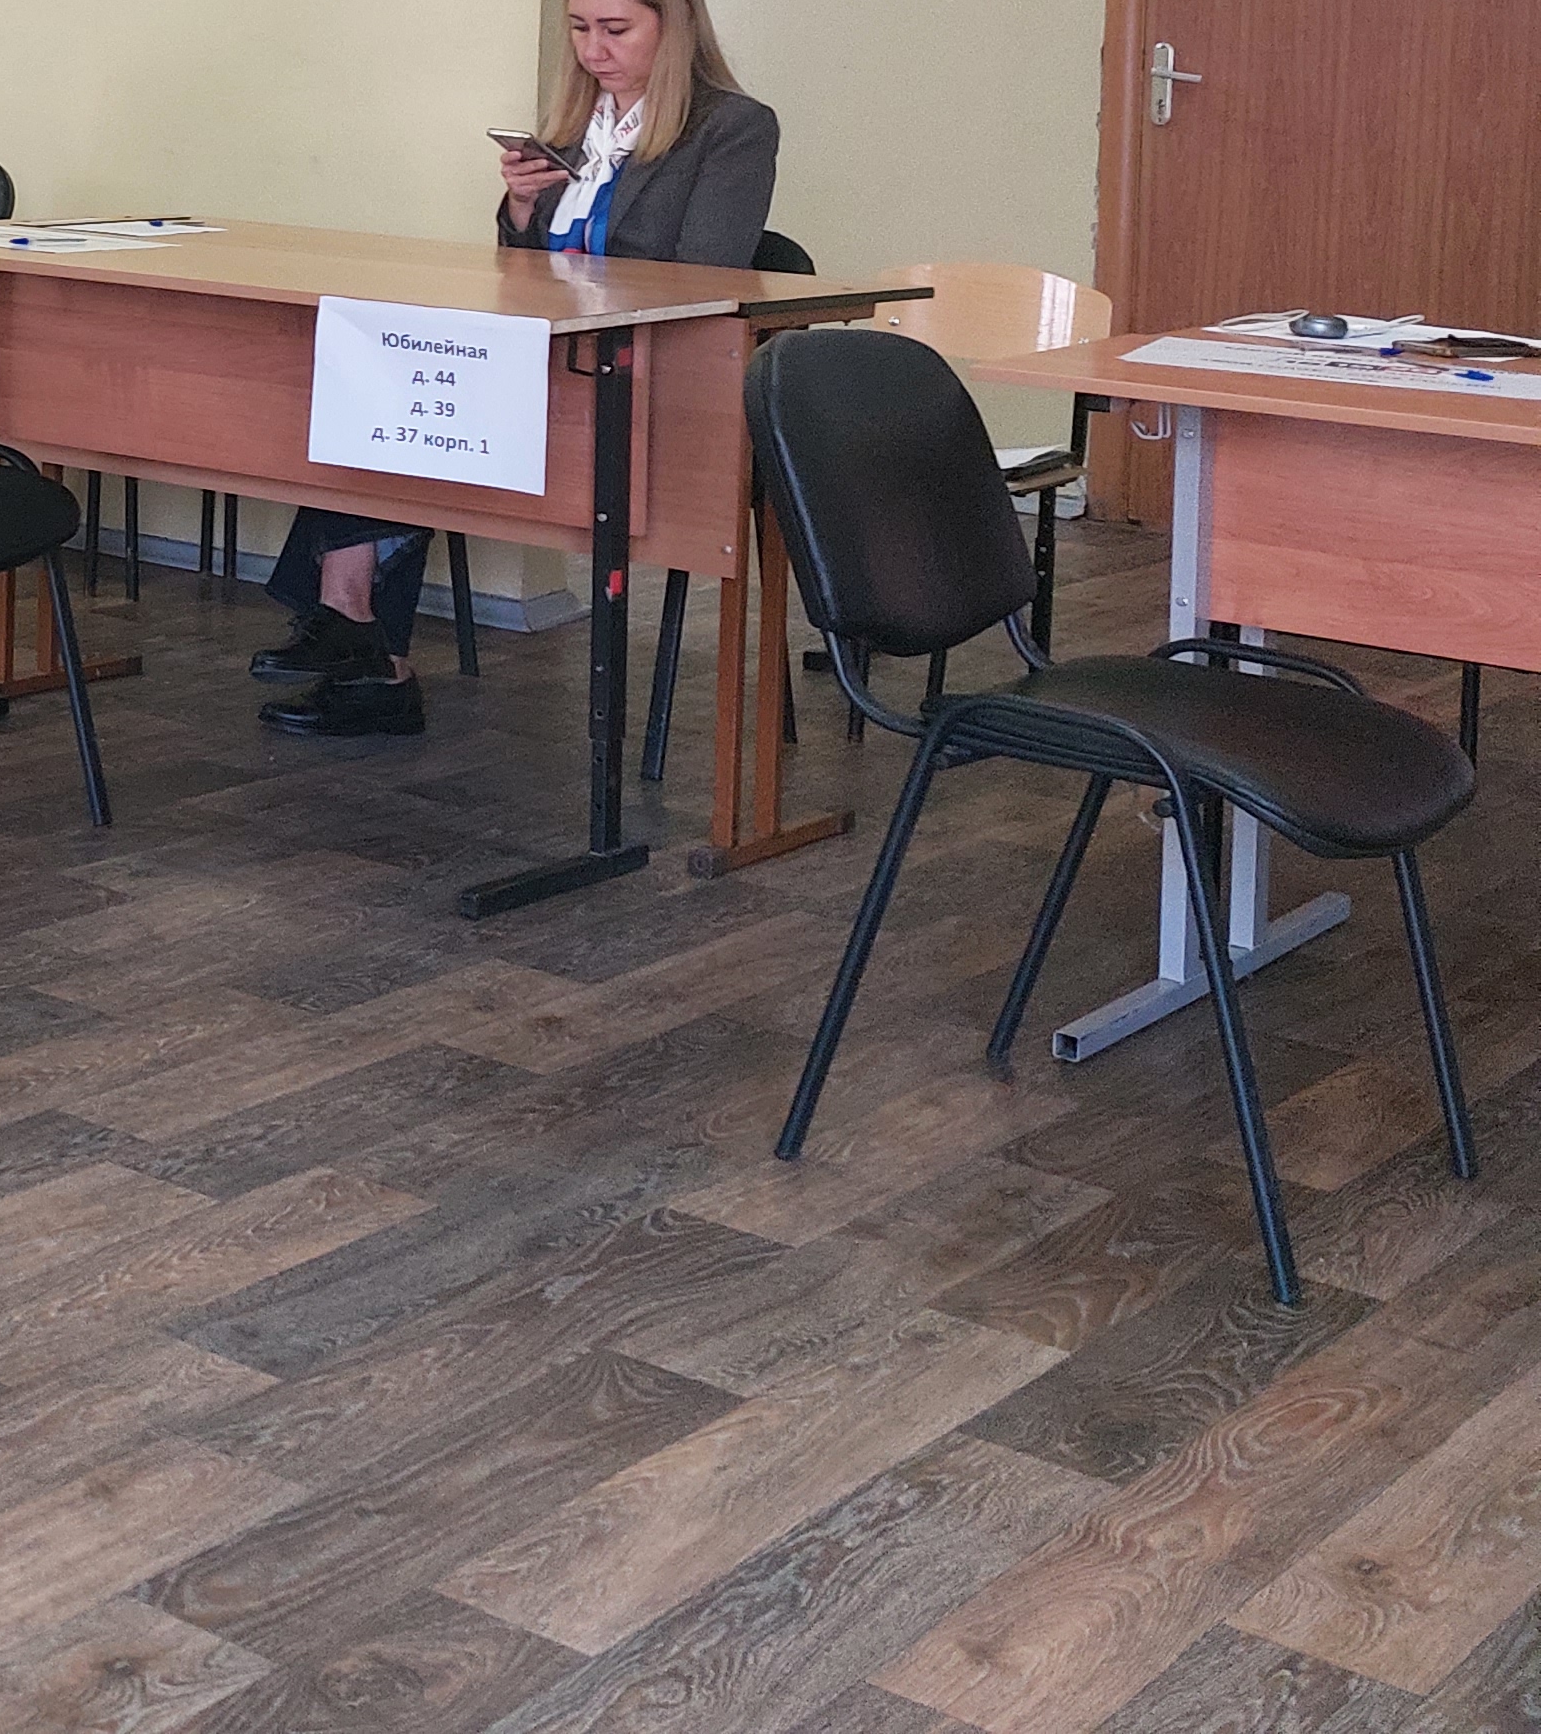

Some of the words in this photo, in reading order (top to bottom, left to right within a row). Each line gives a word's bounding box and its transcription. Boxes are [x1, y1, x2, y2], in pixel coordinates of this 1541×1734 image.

[381, 331, 489, 361] Юбилейная
[411, 370, 430, 385] д.
[434, 371, 457, 387] 44
[410, 401, 429, 417] д.
[433, 401, 456, 418] 39
[371, 427, 391, 442] д.
[395, 426, 419, 444] 37
[423, 433, 475, 453] корп.
[479, 439, 490, 455] 1
